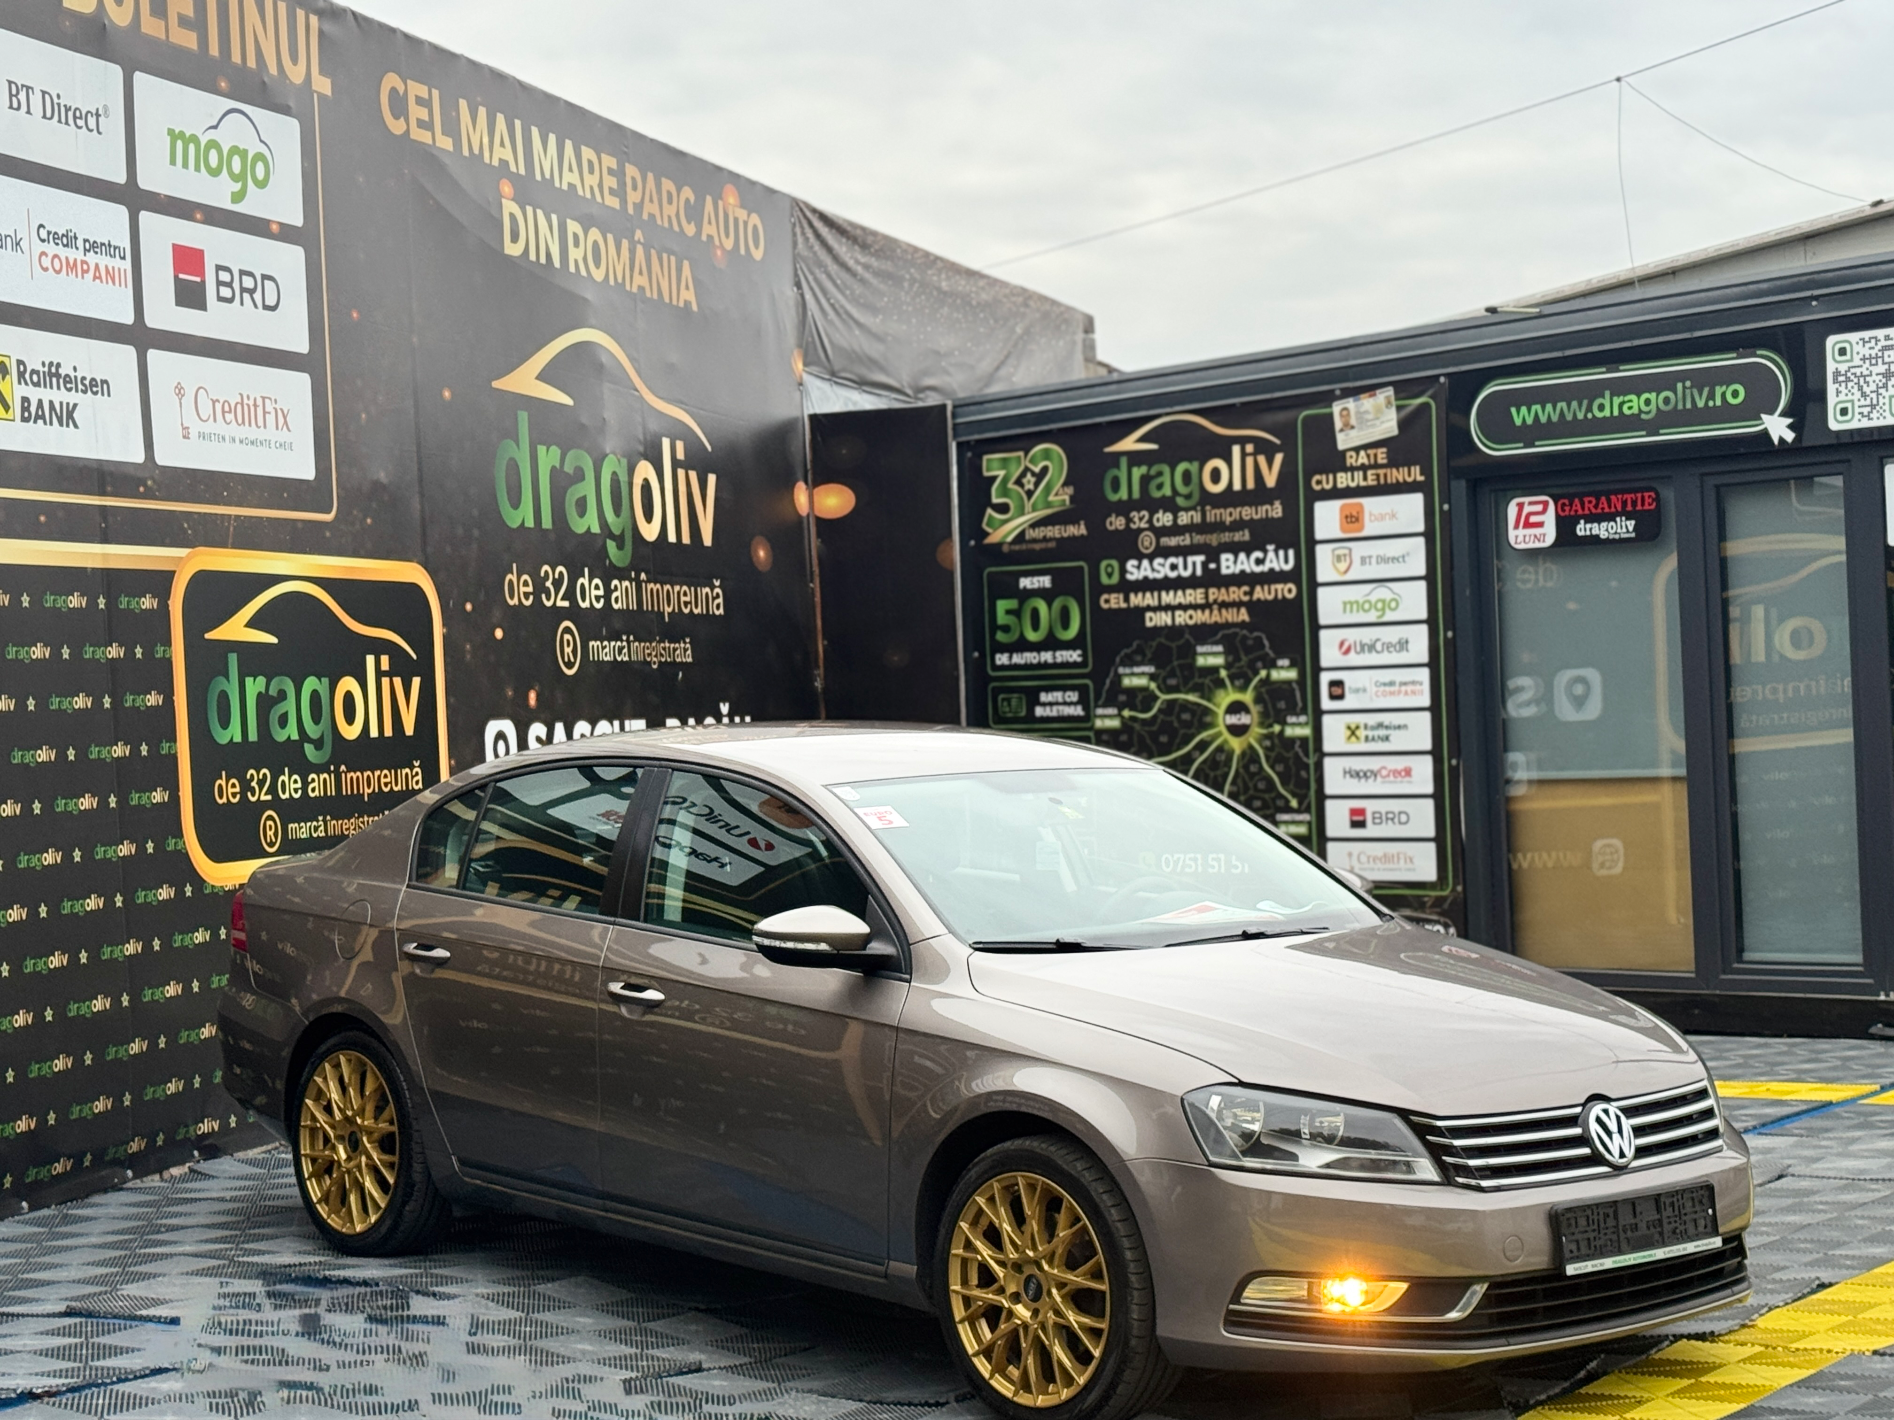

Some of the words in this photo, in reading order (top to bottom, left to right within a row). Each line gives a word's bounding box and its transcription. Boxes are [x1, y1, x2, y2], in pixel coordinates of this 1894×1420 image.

[5, 78, 35, 116] BT
[166, 126, 271, 204] mogo
[379, 72, 454, 152] CEL
[459, 98, 525, 175] MAI
[530, 124, 621, 209] MARE
[625, 162, 697, 237] PARC
[701, 194, 765, 261] AUTO
[36, 222, 80, 251] Credit
[82, 237, 127, 261] pentru
[501, 197, 561, 269] DIN
[565, 217, 698, 312] ROMÂNIA
[38, 250, 129, 289] COMPANII
[214, 263, 282, 313] BRD
[15, 358, 112, 399] Raiffeisen
[19, 396, 80, 431] BANK
[193, 385, 292, 433] CreditFix
[1510, 380, 1746, 427] www.dragoliv.ro
[197, 430, 227, 444] PRIETEN
[228, 435, 237, 445] IN
[238, 436, 273, 450] MOMENTE
[274, 440, 294, 452] CHEIE
[1345, 447, 1388, 468] RATE
[1103, 442, 1285, 508] dragoliv
[1311, 473, 1334, 491] CU
[1335, 465, 1425, 489] BULETINUL
[494, 410, 717, 567] dragoliv
[1105, 513, 1126, 531] de
[1129, 510, 1150, 529] 32
[1152, 509, 1174, 528] de
[1176, 506, 1201, 525] ani
[1204, 500, 1283, 526] împreună
[1344, 511, 1360, 526] tbi
[1368, 508, 1399, 523] bank
[1513, 499, 1550, 531] 12
[1556, 491, 1657, 517] GARANTIE
[1159, 533, 1191, 547] marcă
[1191, 528, 1251, 547] înregistrată
[1513, 532, 1547, 546] LUNI
[1575, 515, 1636, 539] dragoliv
[1125, 555, 1205, 581] SASCUT
[1219, 544, 1295, 576] BACĂU
[1360, 554, 1374, 567] BT
[504, 562, 534, 606] de
[540, 564, 570, 607] 32
[576, 567, 605, 609] de
[610, 571, 638, 611] ani
[639, 571, 725, 623] împreună
[1018, 575, 1052, 590] PESTE
[1099, 593, 1128, 609] CEL
[1129, 592, 1159, 608] MAI
[1160, 588, 1206, 606] MARE
[1207, 586, 1250, 604] PARC
[1252, 582, 1297, 601] AUTO
[43, 591, 88, 612] dragoliv
[118, 593, 159, 613] dragoliv
[1341, 597, 1400, 620] mogo
[994, 594, 1081, 644] 500
[1144, 610, 1173, 628] DIN
[1174, 604, 1250, 626] ROMÂNIA
[5, 643, 51, 663] dragoliv
[83, 642, 125, 663] dragoliv
[588, 634, 629, 662] marcă
[629, 634, 694, 670] înregistrată
[994, 652, 1010, 666] DE
[1011, 651, 1039, 665] AUTO
[1040, 651, 1054, 664] PE
[1054, 649, 1083, 663] STOC
[1353, 637, 1410, 655] UniCredit
[1039, 691, 1064, 704] RATE
[1064, 690, 1079, 703] CU
[1374, 680, 1397, 688] Credit
[1374, 688, 1424, 698] COMPANII
[49, 692, 93, 713] dragoliv
[123, 690, 164, 711] dragoliv
[207, 652, 422, 764] dragoliv
[1363, 721, 1409, 732] Raiffeisen
[1363, 733, 1392, 744] BANK
[10, 745, 57, 767] dragoliv
[88, 741, 131, 762] dragoliv
[214, 770, 241, 805] de
[246, 767, 272, 802] 32
[277, 766, 302, 800] de
[307, 764, 336, 798] ani
[339, 760, 424, 802] împreună
[1343, 765, 1413, 783] HappyCredit
[54, 793, 98, 814] dragoliv
[128, 787, 169, 807] dragoliv
[288, 815, 326, 840] marcă
[876, 815, 894, 826] 5
[1371, 810, 1411, 826] BRD
[17, 847, 63, 870] dragoliv
[94, 839, 137, 861] dragoliv
[1356, 850, 1415, 866] CreditFix
[60, 893, 105, 916] dragoliv
[134, 883, 176, 905] dragoliv
[22, 950, 69, 974] dragoliv
[100, 938, 143, 961] dragoliv
[172, 926, 211, 949] dragoliv
[66, 994, 112, 1018] dragoliv
[141, 981, 183, 1003] dragoliv
[27, 1053, 73, 1079] dragoliv
[105, 1037, 149, 1061] dragoliv
[178, 1021, 217, 1044] dragoliv
